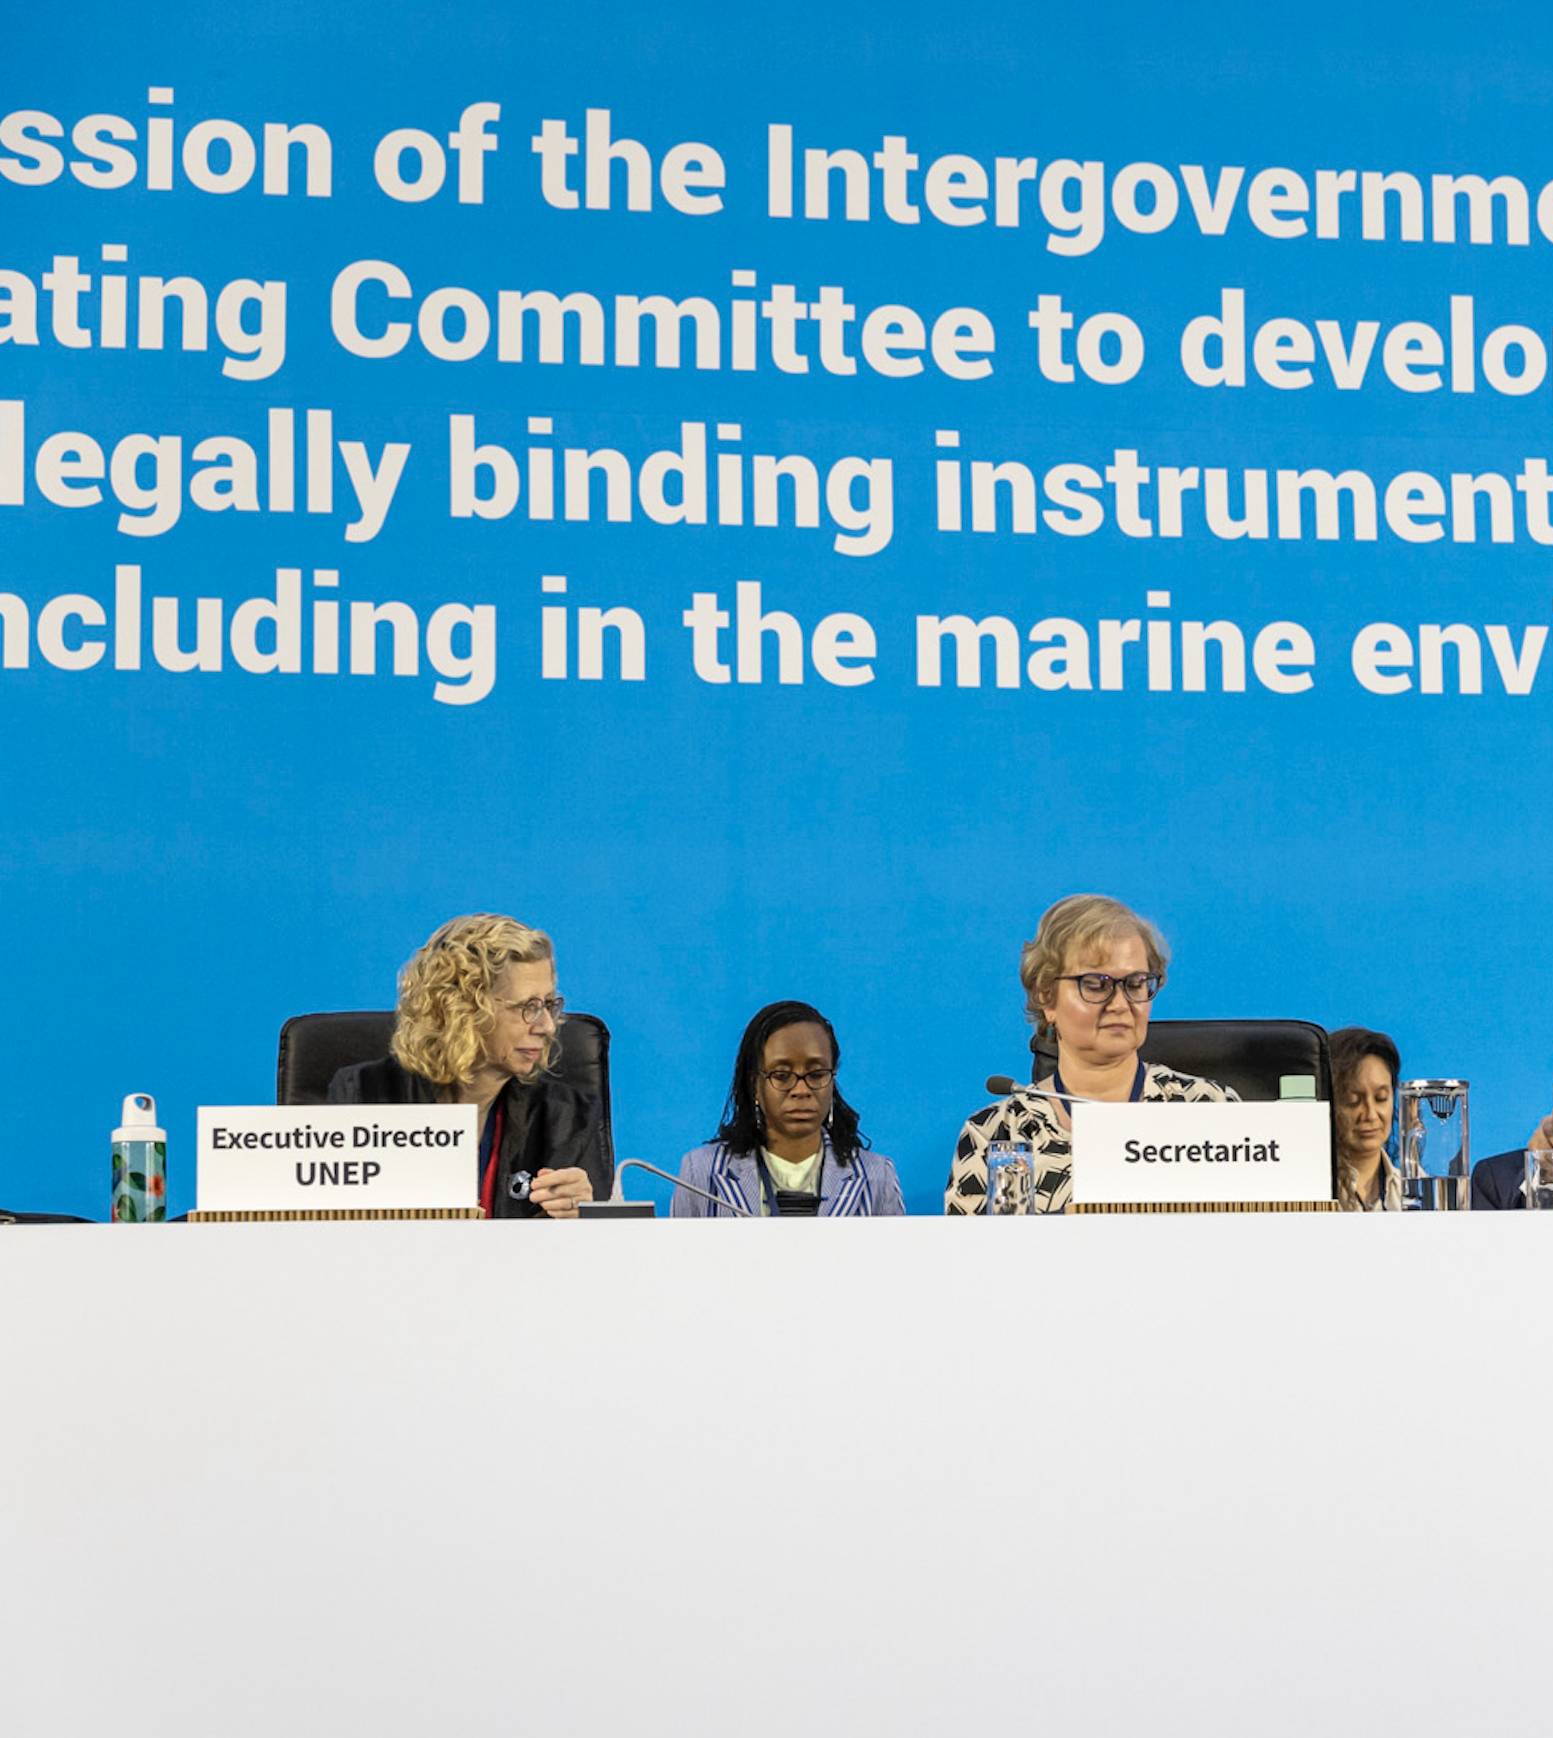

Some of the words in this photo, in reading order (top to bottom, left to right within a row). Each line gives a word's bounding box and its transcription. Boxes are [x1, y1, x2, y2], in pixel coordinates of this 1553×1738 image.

[0, 87, 332, 198] ssion
[374, 101, 501, 204] of
[531, 108, 726, 215] the
[331, 259, 995, 380] Committee
[1028, 294, 1145, 385] to
[0, 400, 412, 543] legally
[449, 414, 894, 557] binding
[541, 575, 646, 681] in
[682, 580, 877, 687] the
[916, 590, 1316, 694] marine
[211, 1123, 345, 1150] Executive
[352, 1122, 465, 1148] Director
[295, 1161, 381, 1186] UNEP
[1123, 1137, 1281, 1164] Secretariat
